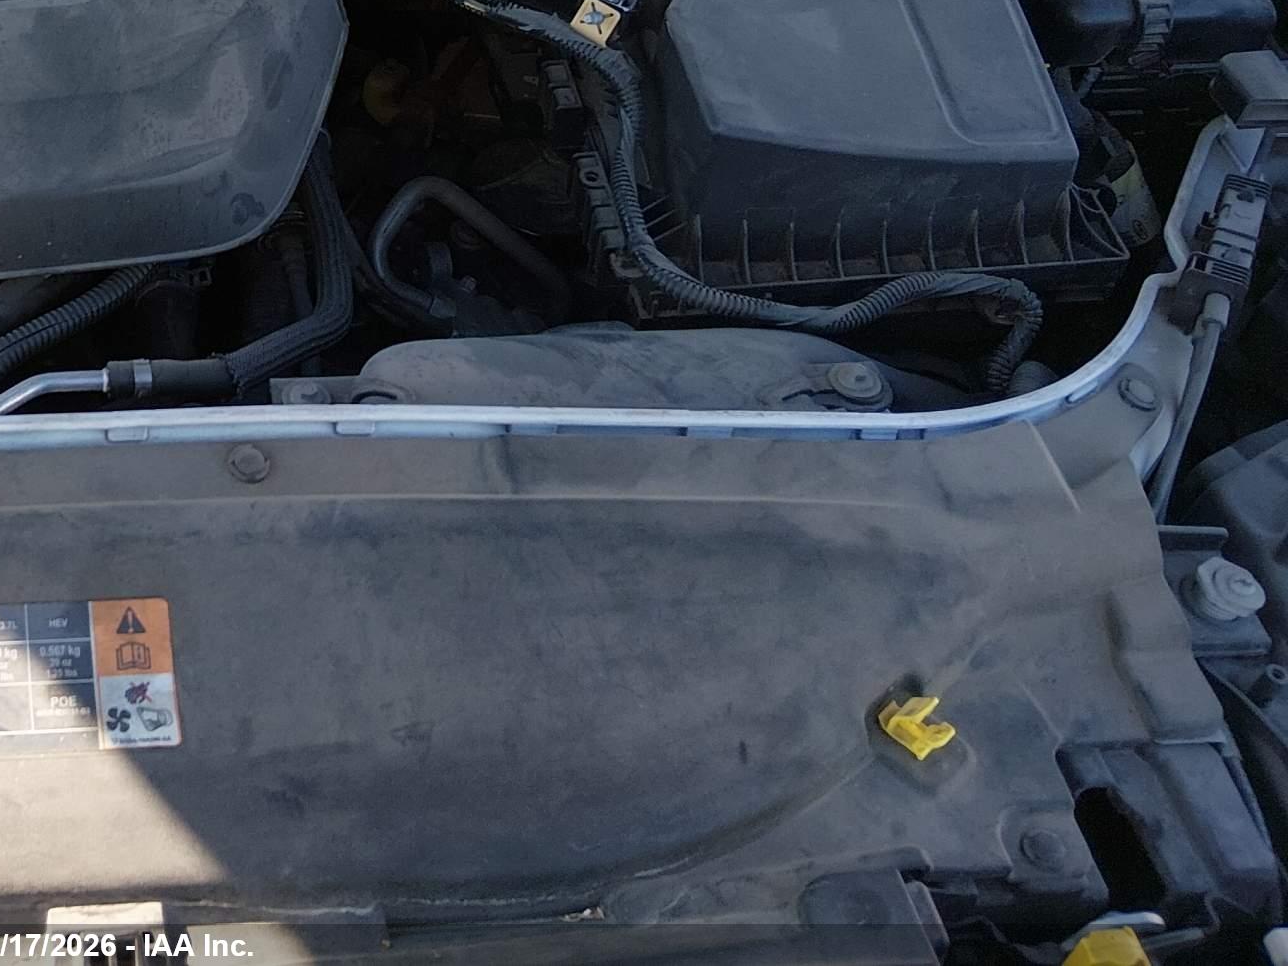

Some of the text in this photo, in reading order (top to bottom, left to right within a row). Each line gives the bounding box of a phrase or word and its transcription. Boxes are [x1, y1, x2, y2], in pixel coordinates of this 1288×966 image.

[48, 617, 68, 628] HEV
[4, 647, 18, 661] kg
[68, 644, 81, 658] kg
[50, 695, 77, 708] POE
